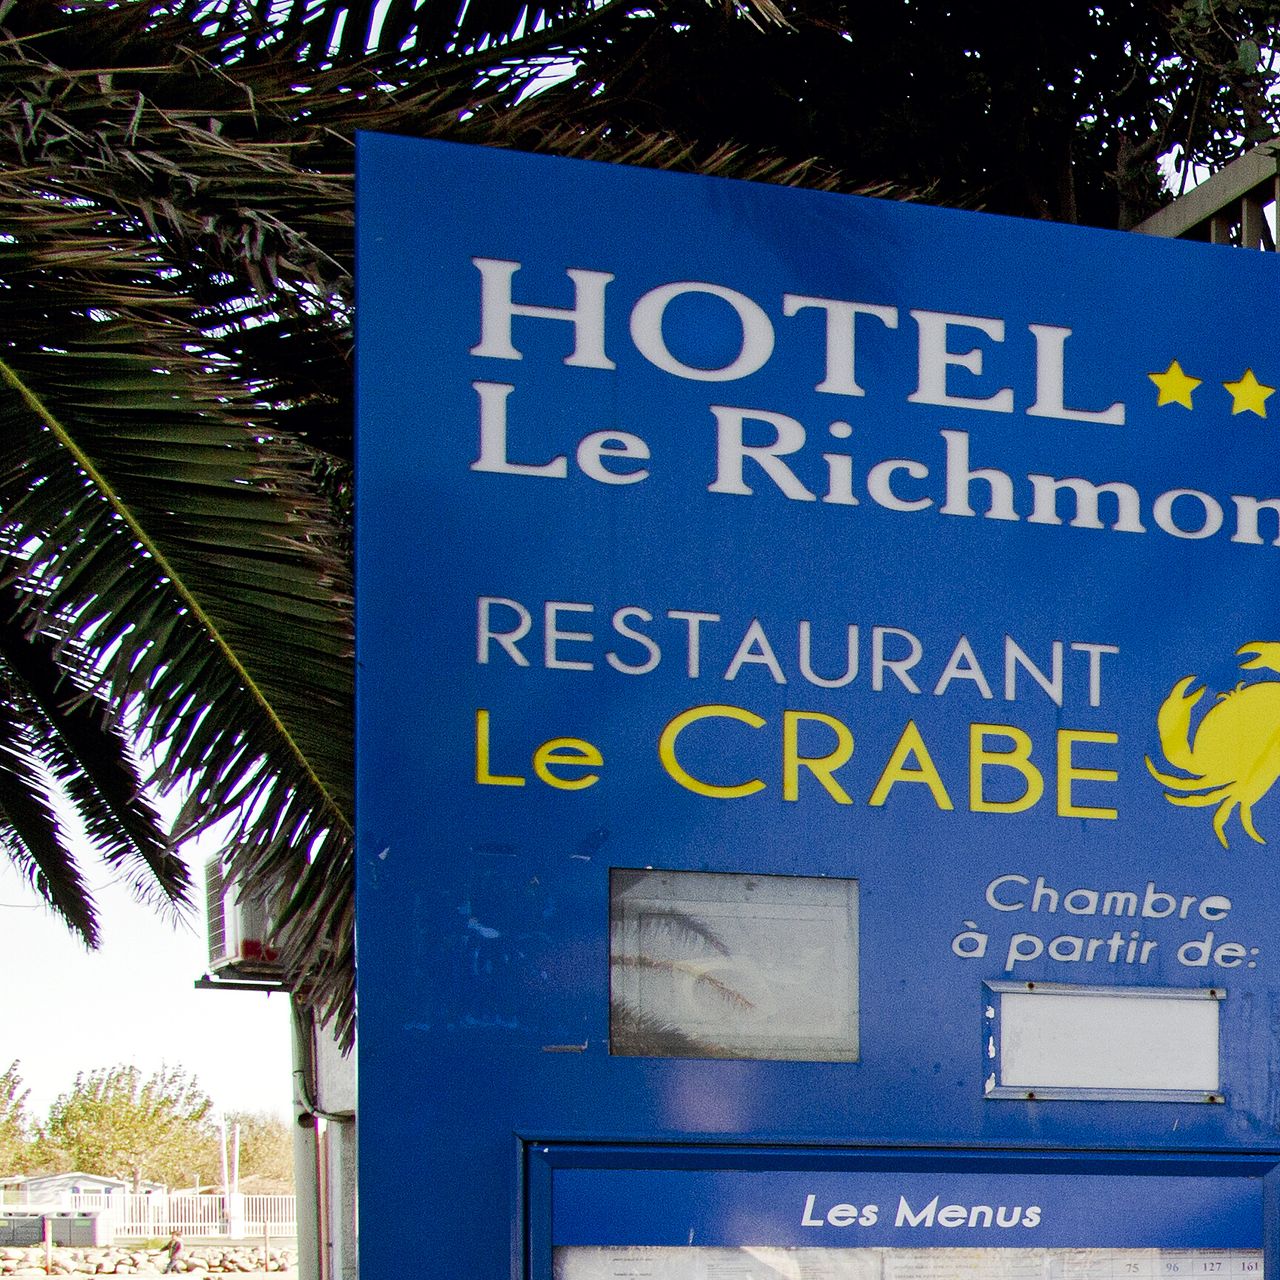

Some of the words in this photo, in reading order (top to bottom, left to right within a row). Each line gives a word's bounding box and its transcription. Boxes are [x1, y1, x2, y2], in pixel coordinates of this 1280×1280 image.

[471, 257, 1125, 426] HOTEL
[471, 381, 651, 486] Le
[477, 597, 1119, 707] RESTAURANT
[476, 709, 603, 792] Le
[658, 705, 1119, 821] CRABE
[985, 874, 1233, 922] Chambre
[951, 919, 988, 959] à
[1004, 930, 1158, 972] partir
[1176, 931, 1260, 969] de:
[800, 1194, 878, 1227] Les
[895, 1195, 1043, 1228] Menus
[1126, 1263, 1140, 1273] 75
[1166, 1263, 1179, 1272] 96
[1203, 1262, 1222, 1272] 127
[1241, 1262, 1259, 1272] 161
